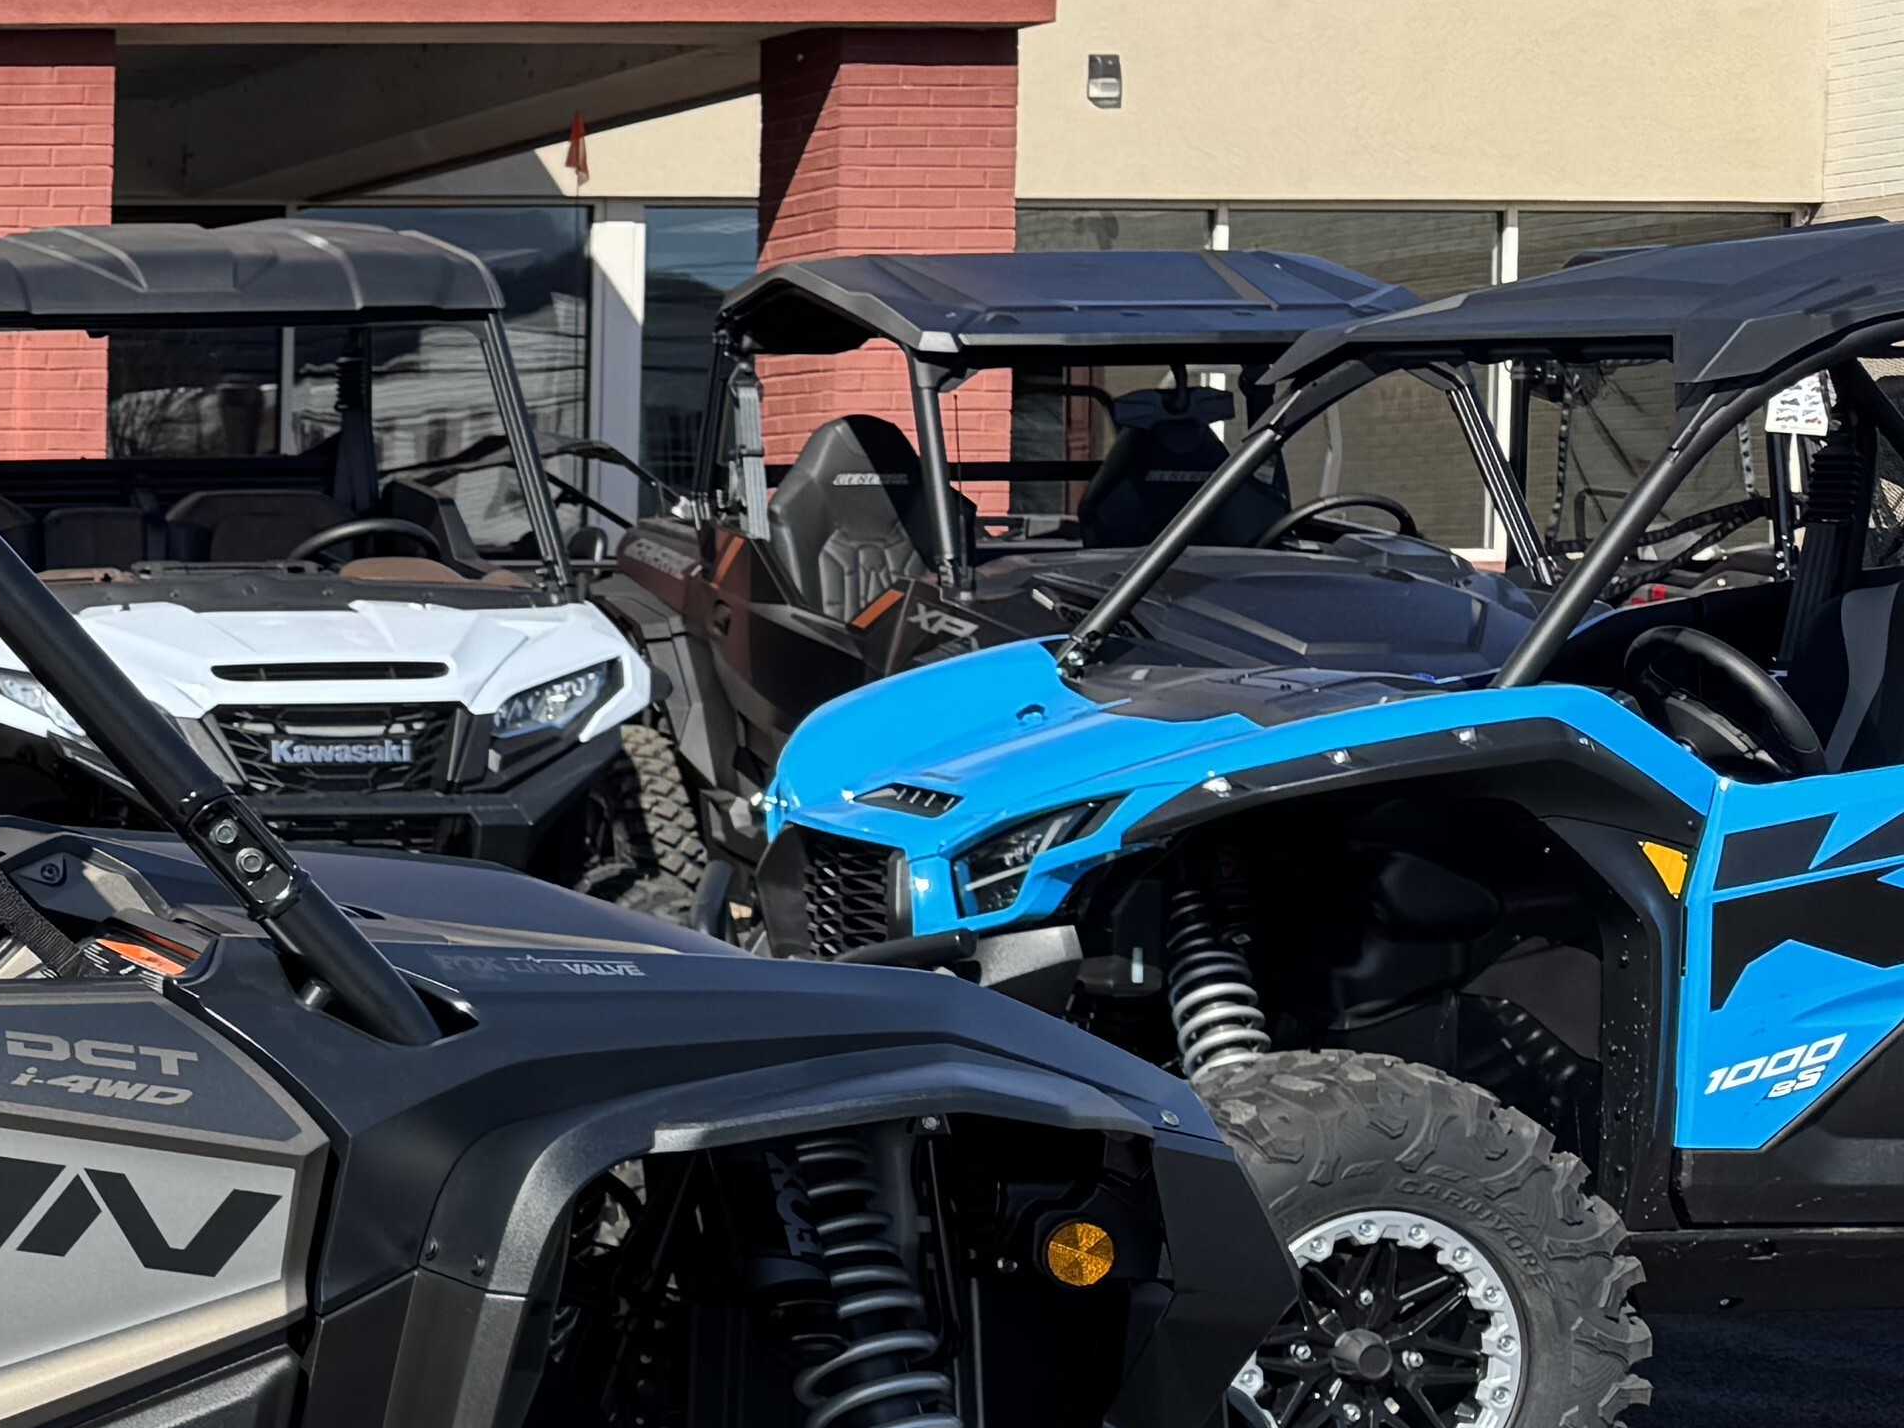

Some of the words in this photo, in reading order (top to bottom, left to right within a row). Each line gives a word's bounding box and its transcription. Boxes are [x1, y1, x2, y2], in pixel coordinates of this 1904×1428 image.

[906, 601, 979, 638] XP
[270, 739, 413, 764] Kawasaki
[563, 962, 647, 977] VALVE
[4, 1030, 199, 1077] DCT
[1703, 1032, 1848, 1095] 1000
[10, 1066, 194, 1106] i-4WD
